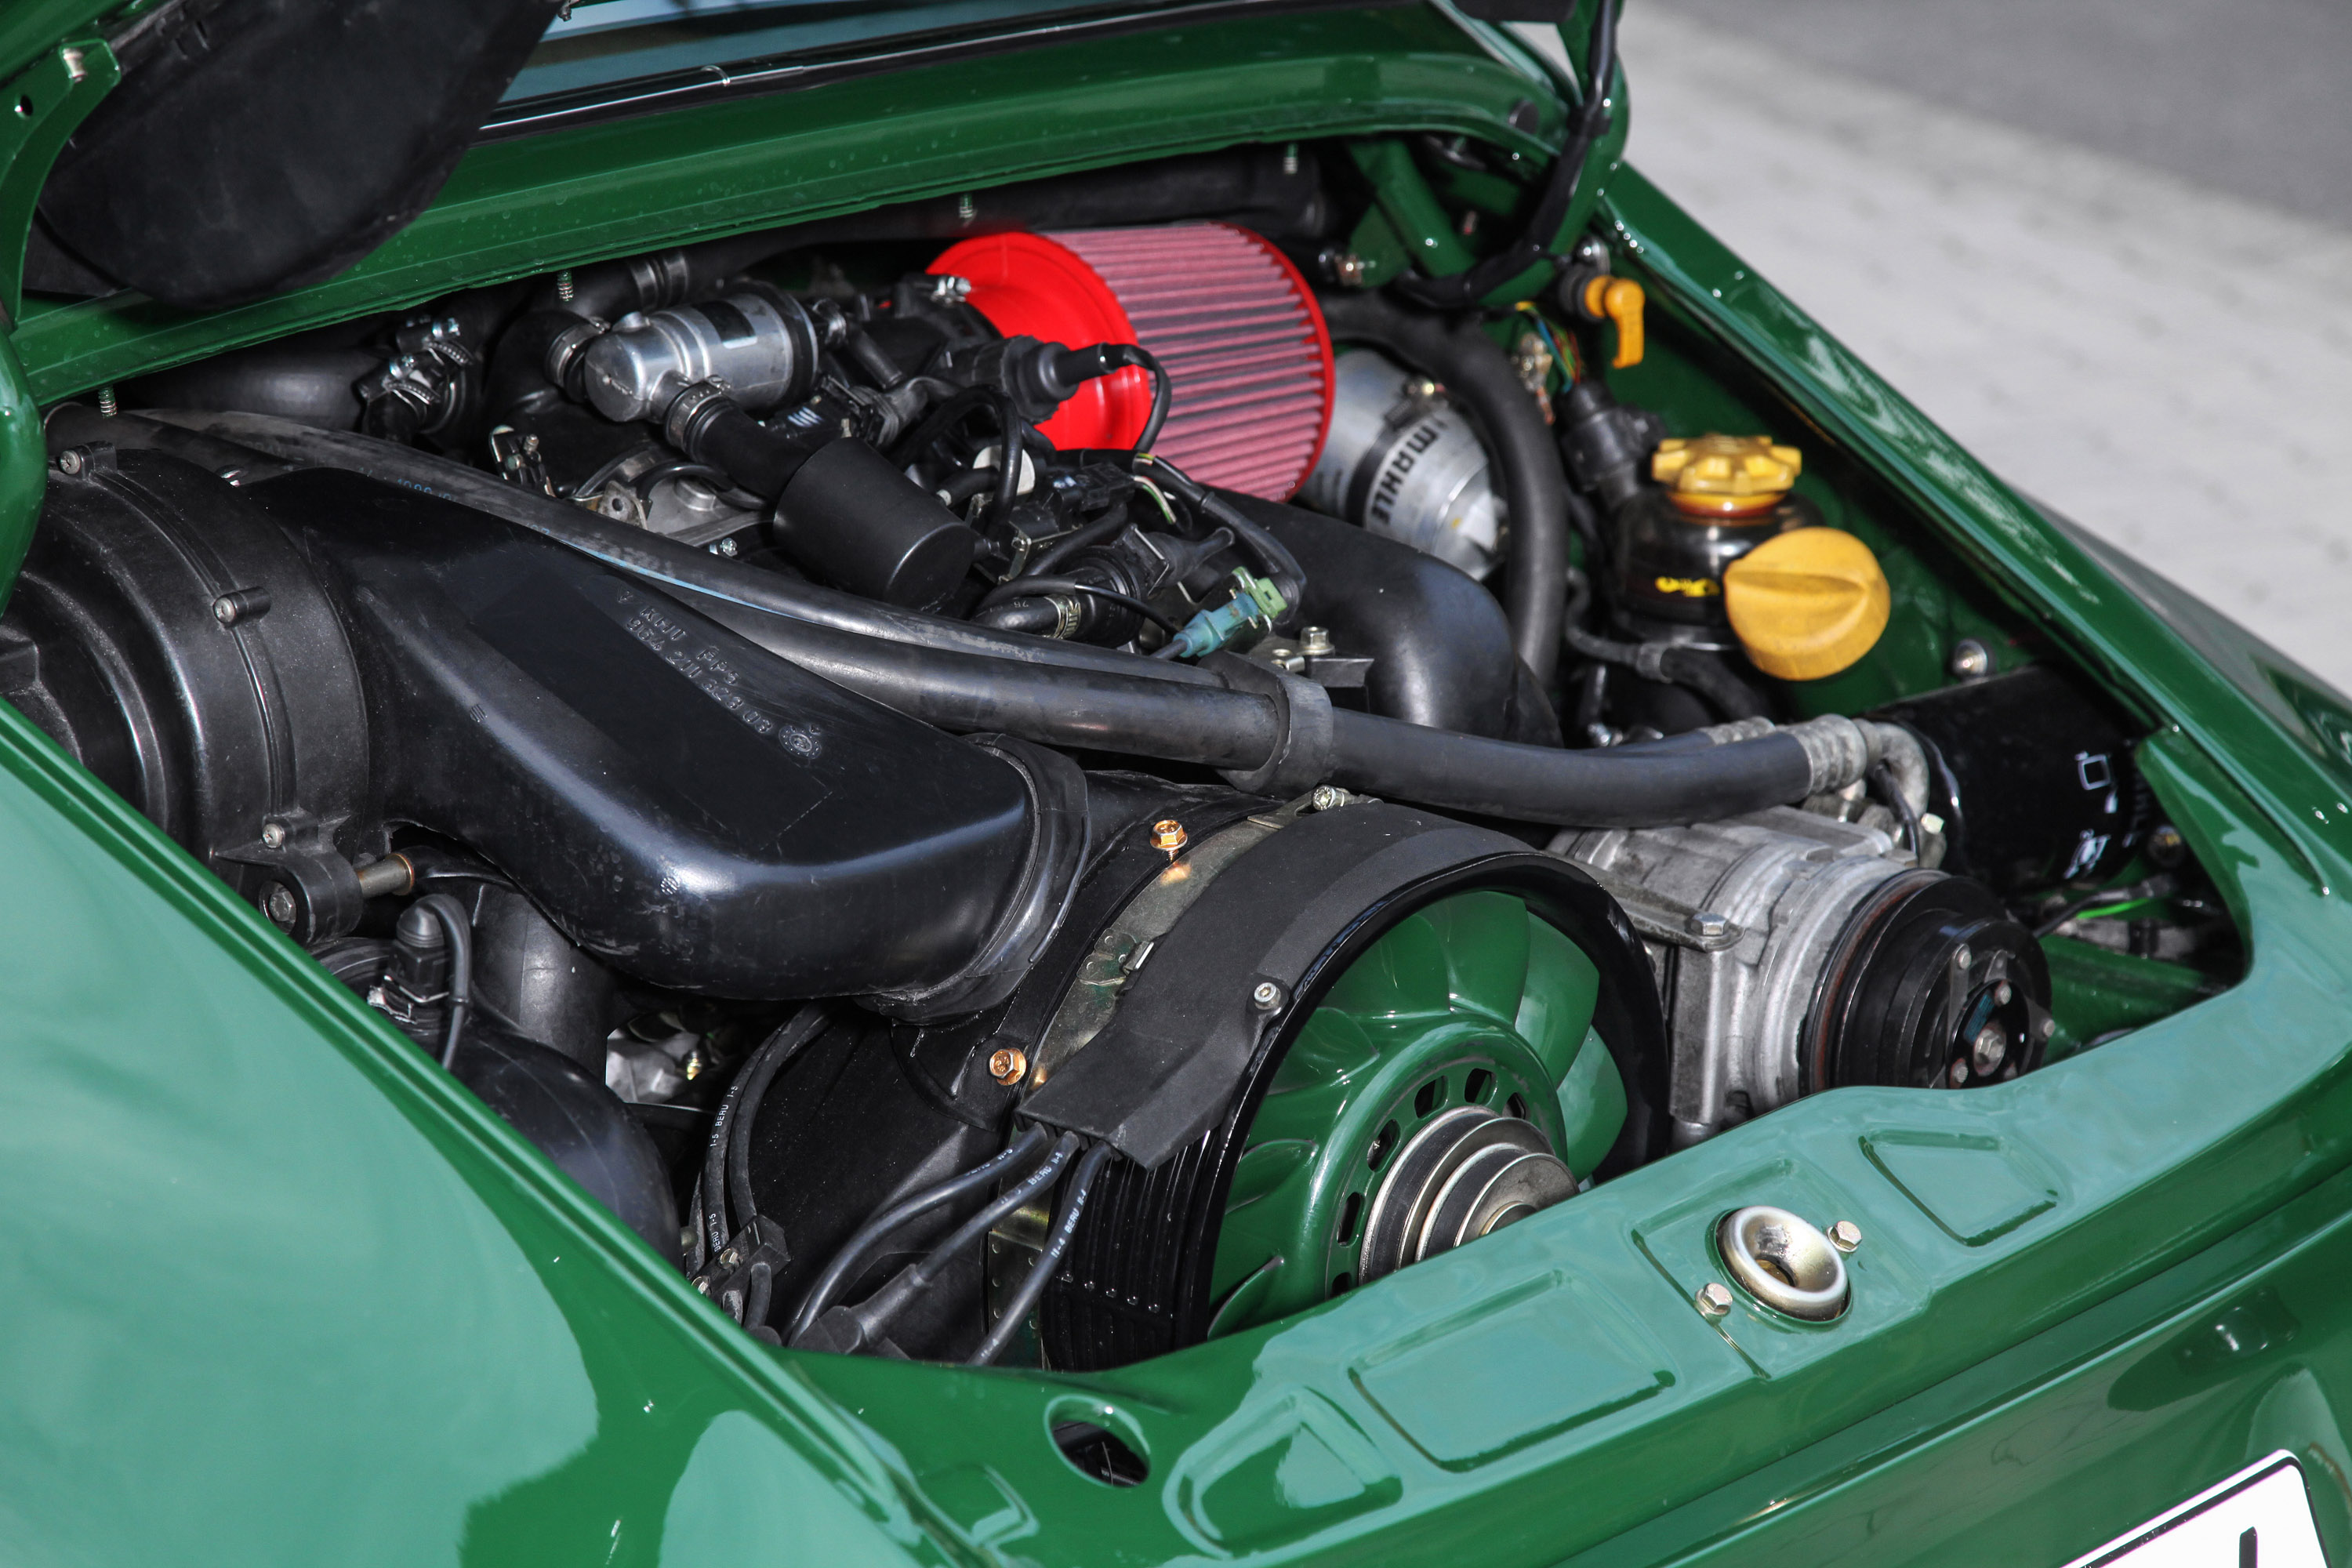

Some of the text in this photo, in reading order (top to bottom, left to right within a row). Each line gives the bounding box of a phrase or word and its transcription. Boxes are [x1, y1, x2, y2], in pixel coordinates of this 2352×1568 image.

[1371, 423, 1439, 525] MAHLE
[626, 616, 665, 652] 964
[665, 651, 703, 679] 211
[742, 710, 774, 735] 03
[714, 1103, 730, 1127] BERU
[1028, 1165, 1053, 1185] BERU
[1063, 1207, 1080, 1234] BERU
[712, 1231, 723, 1253] BERU
